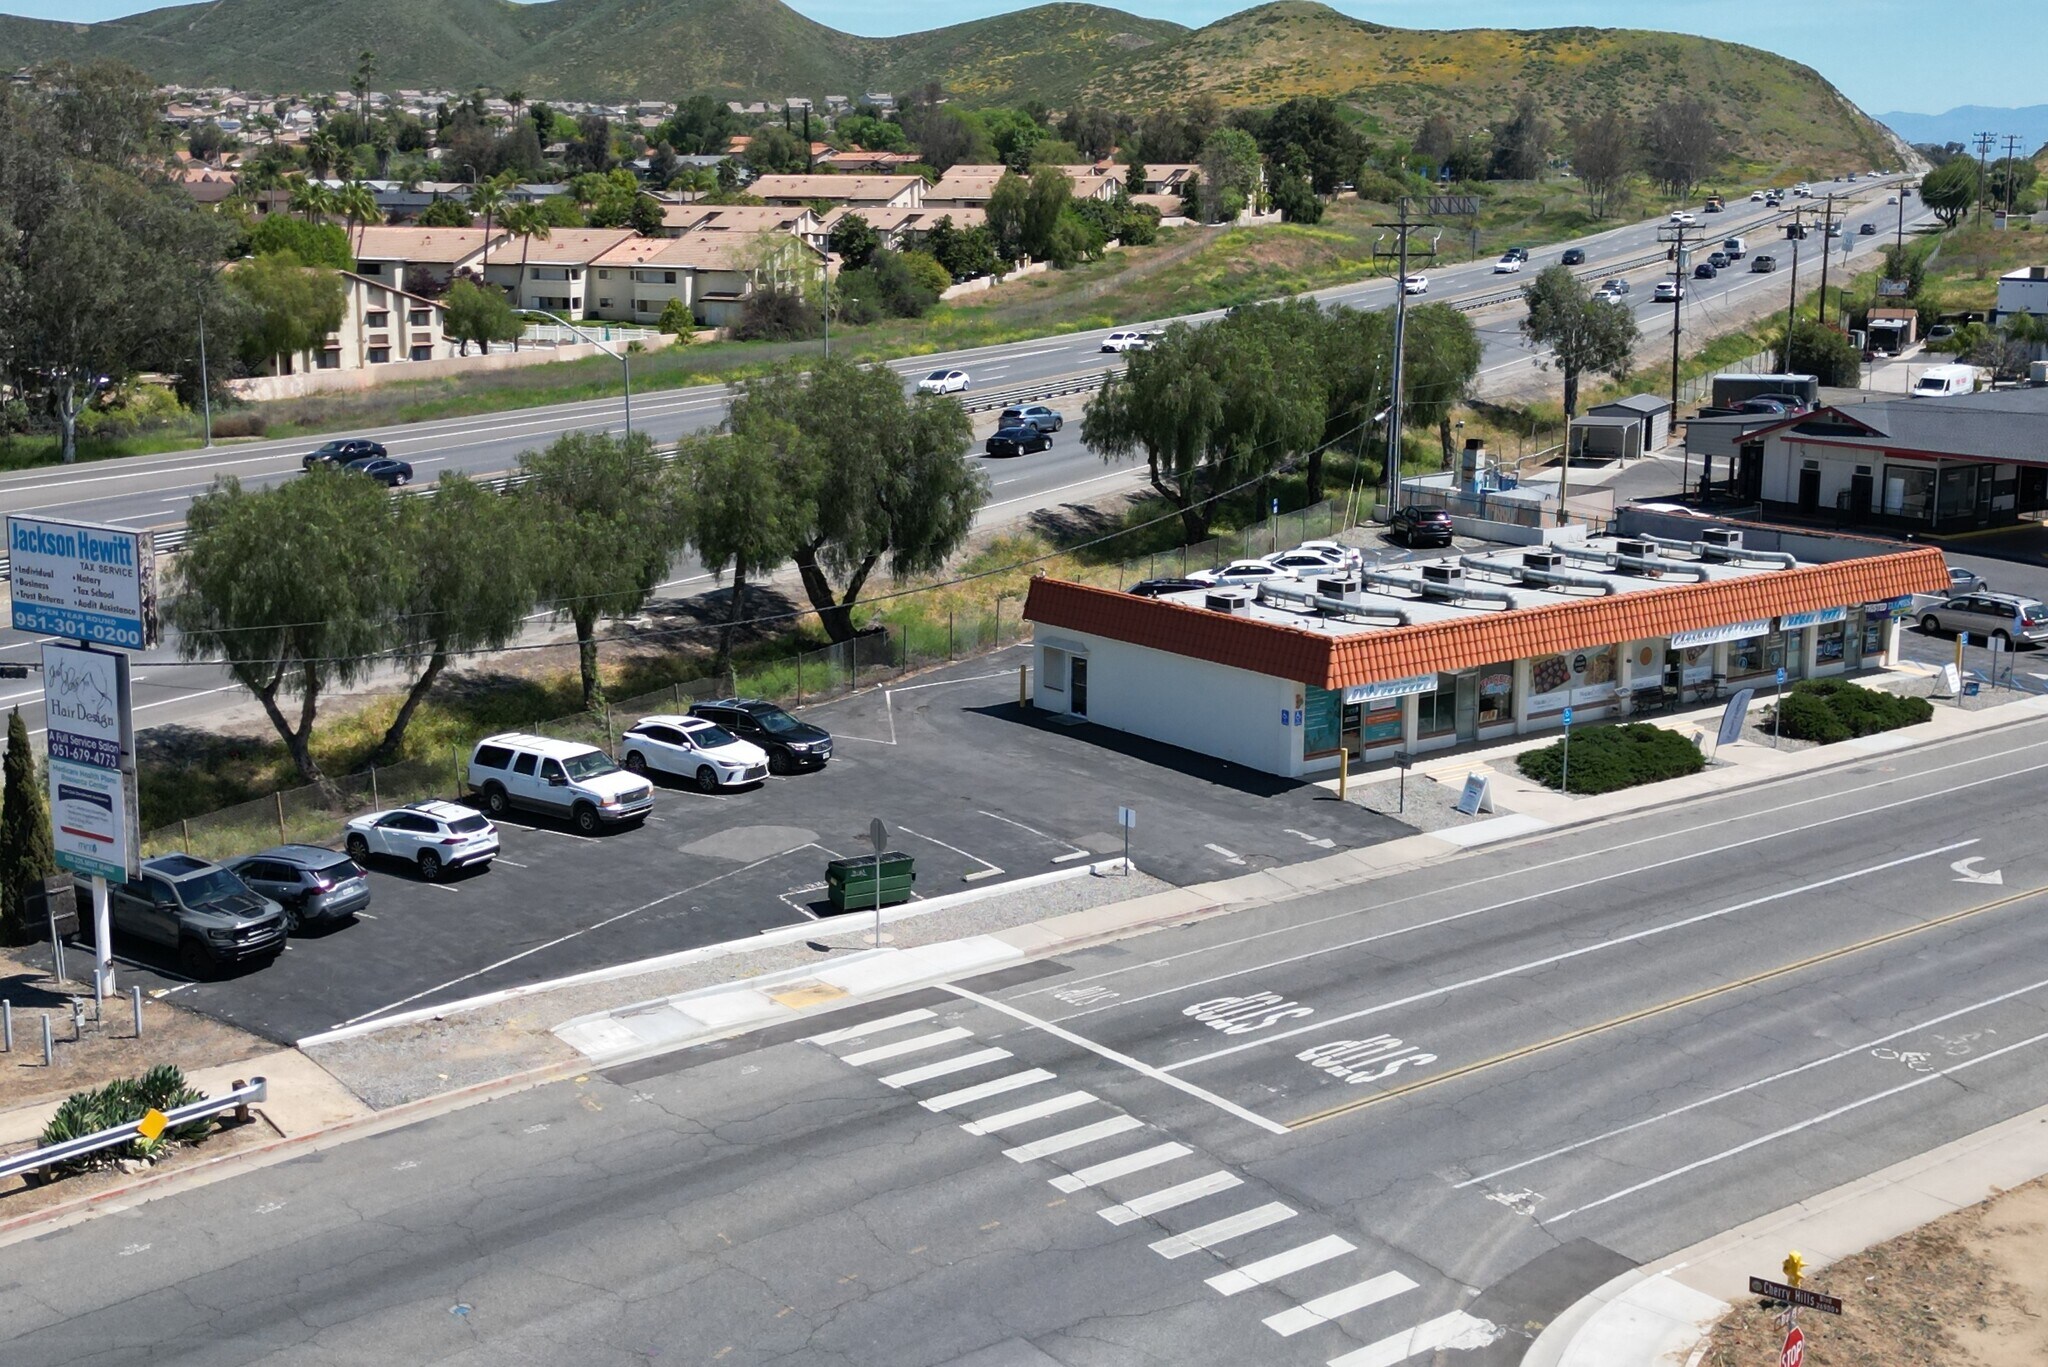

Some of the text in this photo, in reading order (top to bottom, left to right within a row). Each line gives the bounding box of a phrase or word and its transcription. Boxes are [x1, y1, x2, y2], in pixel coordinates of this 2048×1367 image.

[12, 522, 132, 566] Jackson Hewitt
[18, 565, 54, 579] Individual
[80, 561, 133, 578] TAX SERVICE
[19, 577, 49, 590] Business
[76, 573, 101, 587] Notary
[19, 590, 65, 605] Trust Returns
[77, 586, 115, 599] Tax School
[35, 607, 117, 627] OPEN YEAR ROUND
[78, 599, 136, 616] Audit Assistance
[15, 611, 139, 645] 951-301-0200
[51, 699, 114, 729] Hair Design
[48, 732, 118, 754] A Full Service Salon
[52, 743, 117, 767] 951-679-4773
[1763, 1281, 1815, 1306] Cherry Hills
[1781, 1340, 1803, 1367] STOP
